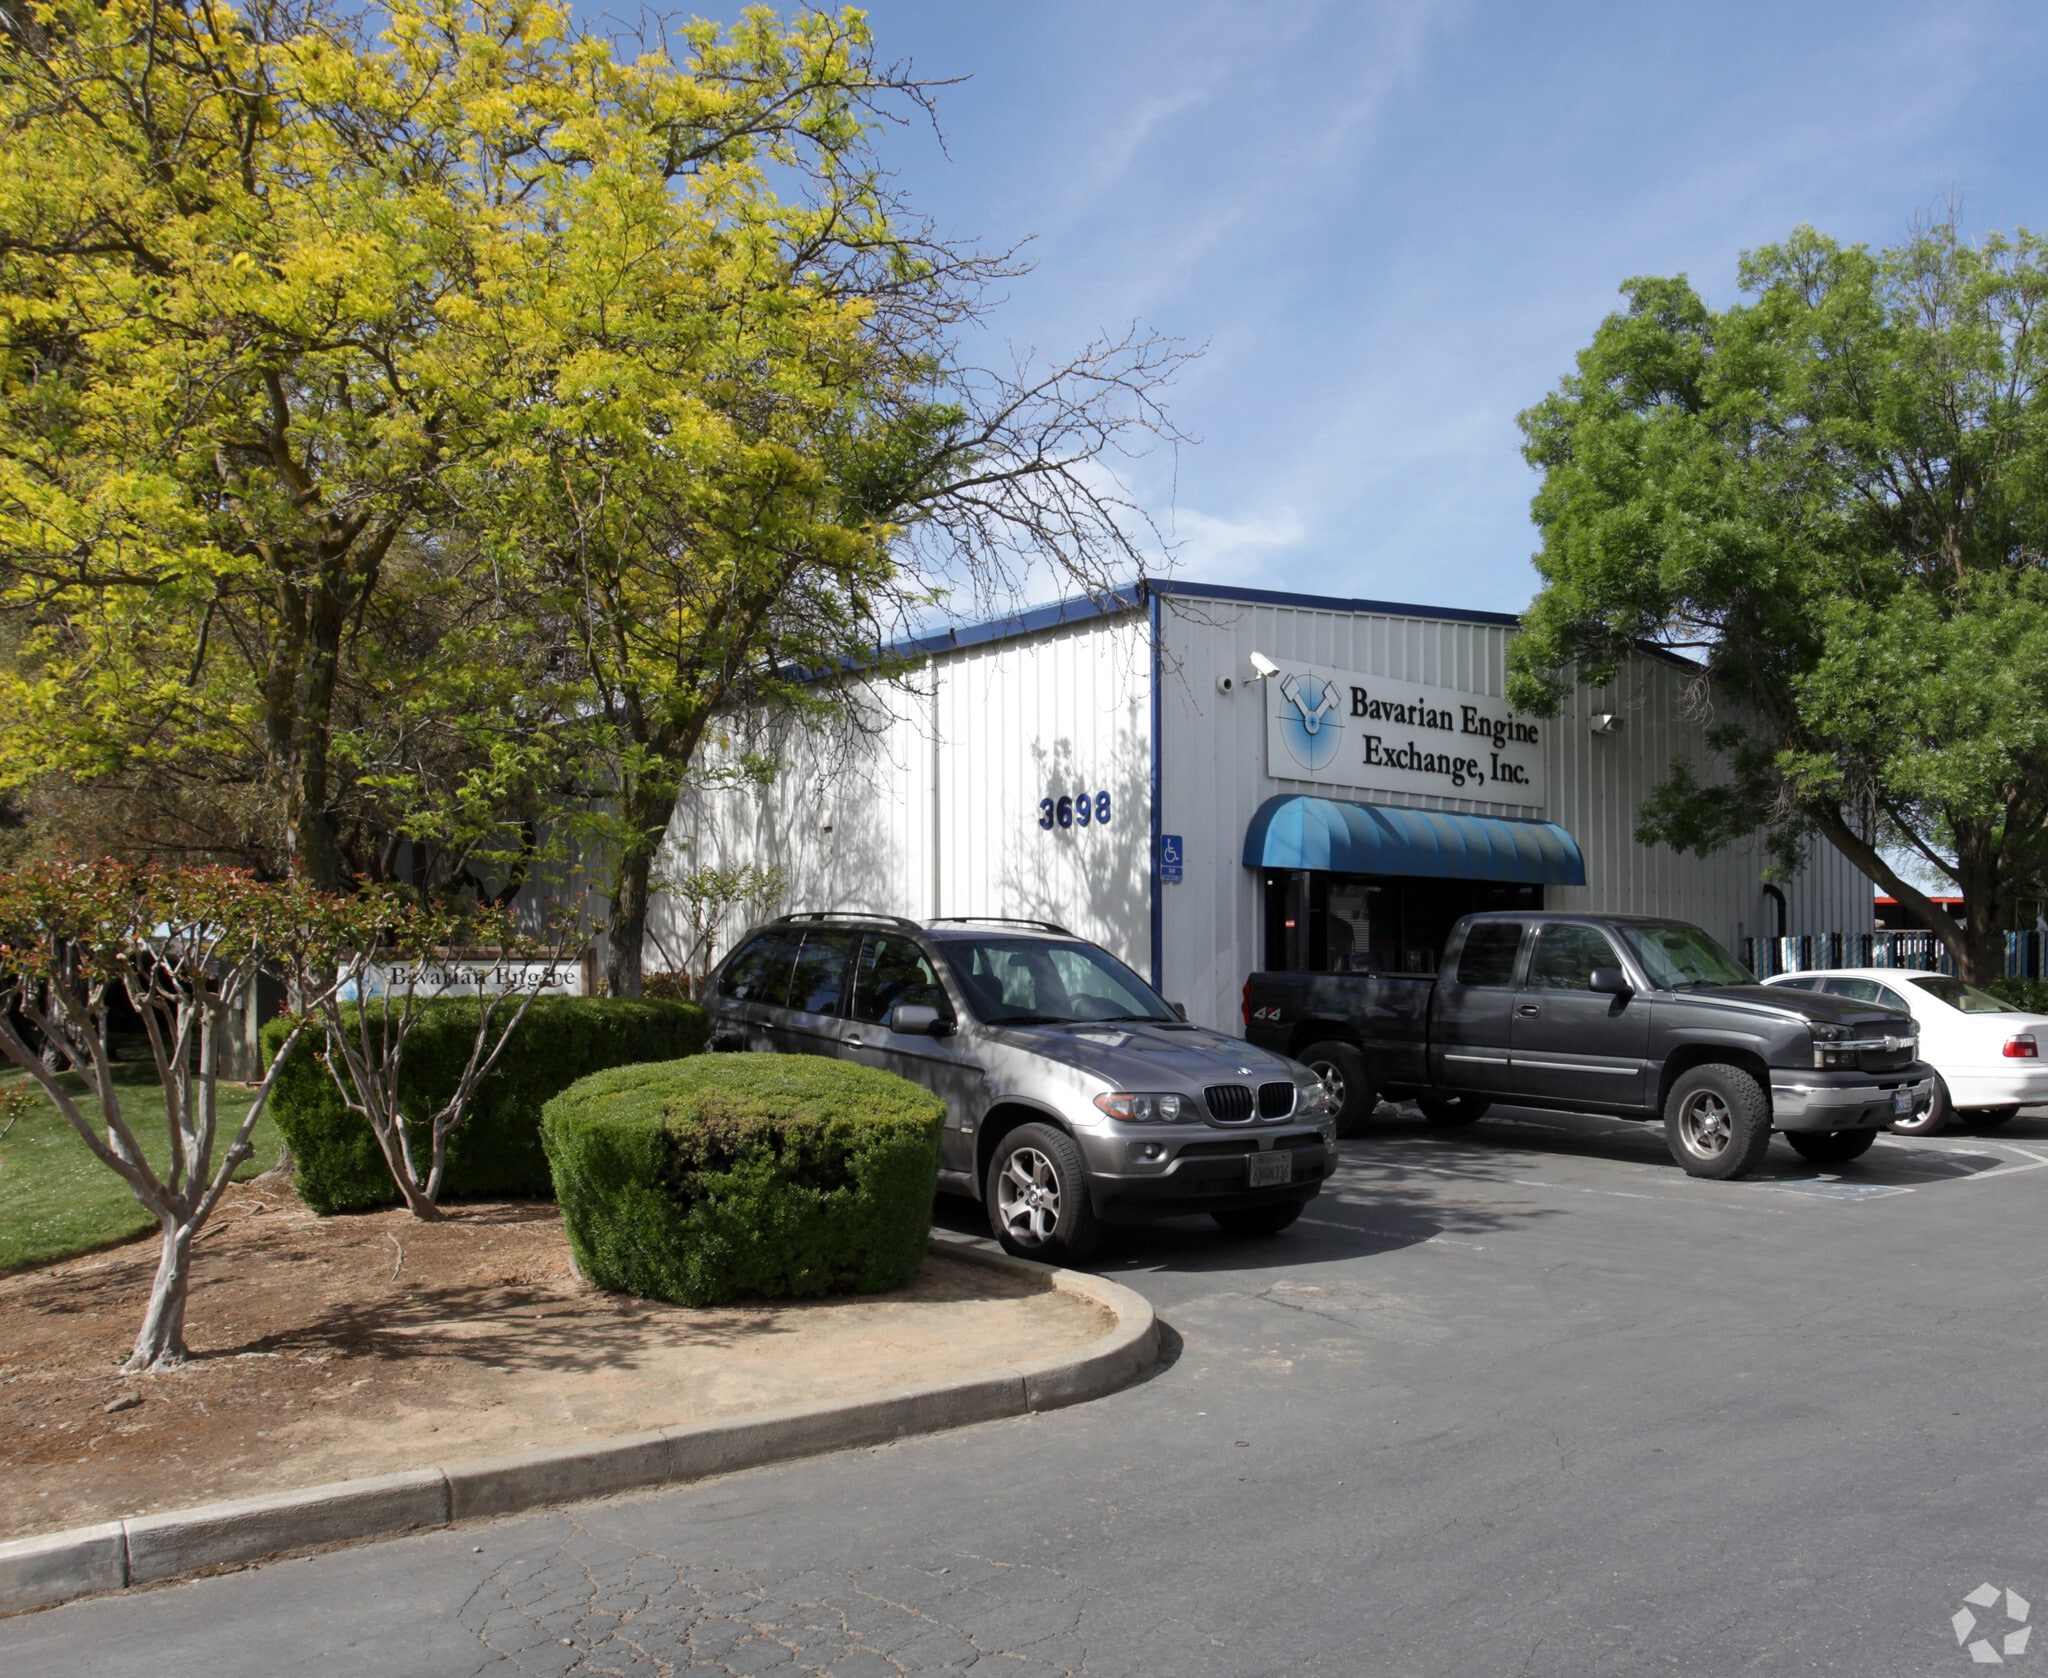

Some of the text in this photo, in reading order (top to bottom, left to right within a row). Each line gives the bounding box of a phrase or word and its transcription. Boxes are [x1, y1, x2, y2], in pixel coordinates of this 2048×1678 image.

[1350, 686, 1539, 748] Bavarian Engine
[1363, 734, 1530, 786] Exchange, Inc.
[1039, 790, 1111, 830] 3698
[391, 966, 576, 991] Bvarian Engne
